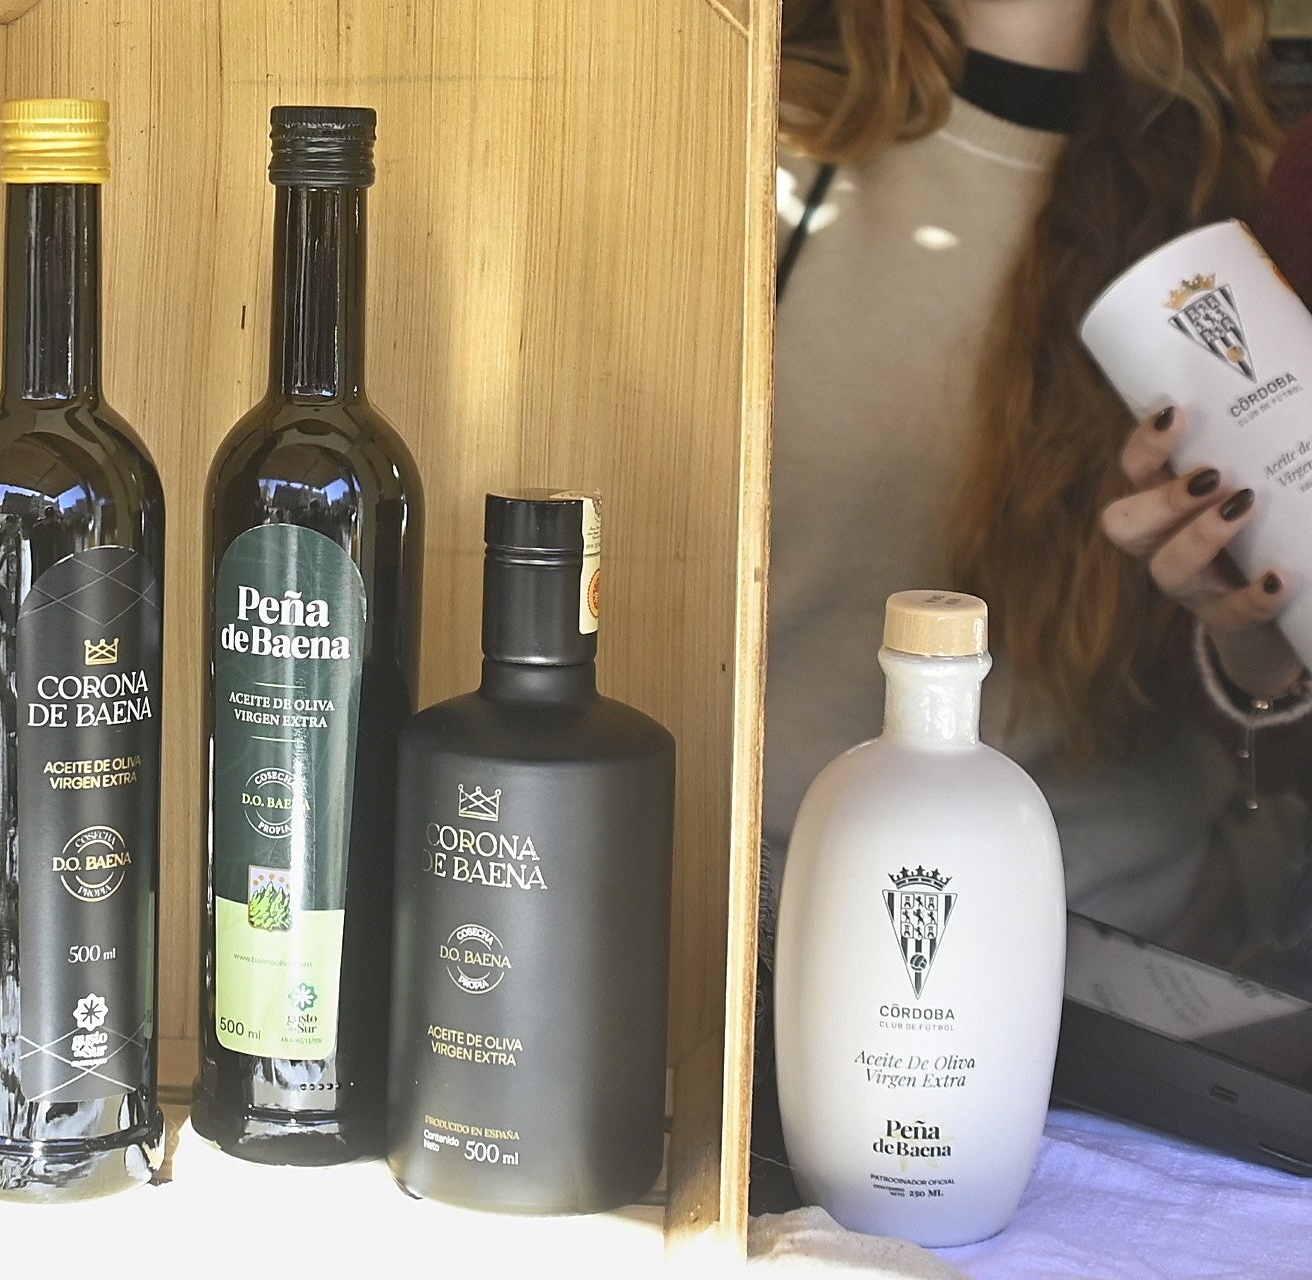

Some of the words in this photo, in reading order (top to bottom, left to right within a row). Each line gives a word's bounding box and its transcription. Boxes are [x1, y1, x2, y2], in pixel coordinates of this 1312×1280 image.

[1265, 449, 1298, 479] Aceite
[1298, 440, 1312, 456] de
[237, 585, 330, 628] Peña
[221, 624, 249, 653] de
[251, 626, 351, 660] Baena
[37, 670, 149, 700] CORONA
[27, 703, 68, 727] DE
[75, 695, 153, 728] BAENA
[229, 691, 270, 708] ACEITE
[272, 698, 293, 710] DE
[294, 700, 335, 712] OLIVA
[234, 708, 279, 726] VIRGEN
[282, 714, 327, 728] EXTRA
[43, 760, 92, 775] ACEITE
[93, 759, 111, 774] DE
[112, 755, 142, 771] OLIVA
[49, 776, 101, 790] VIRGEN
[102, 772, 138, 787] EXTRA
[241, 792, 265, 807] D.O.
[74, 830, 116, 849] COSECHA
[426, 822, 540, 861] CORONA
[52, 856, 81, 872] D.O.
[85, 852, 132, 870] BAENA
[452, 856, 548, 890] BAENA
[77, 884, 112, 898] PROPIA
[456, 927, 494, 946] COSECHA
[68, 944, 101, 964] 500
[103, 947, 116, 961] ml
[440, 945, 461, 962] D.O.
[464, 950, 512, 969] BAENA
[457, 974, 490, 990] PROPIA
[220, 1016, 245, 1036] 500
[248, 1030, 261, 1040] ml
[287, 1013, 318, 1026] gusto
[297, 1023, 317, 1034] Sur
[879, 1021, 903, 1029] CLUB
[427, 1024, 464, 1044] ACEITE
[466, 1033, 483, 1047] DE
[484, 1036, 523, 1052] OLIVA
[431, 1040, 472, 1062] VIRGEN
[474, 1050, 517, 1066] EXTRA
[854, 1051, 903, 1069] Aceite
[907, 1055, 930, 1071] De
[934, 1054, 976, 1071] Oliva
[866, 1068, 917, 1089] Virgen
[922, 1073, 967, 1088] Extra
[423, 1128, 460, 1147] Contenido
[424, 1114, 470, 1134] PRODUCIDO
[470, 1126, 483, 1137] EN
[484, 1128, 520, 1141] ESPAÑA
[886, 1119, 940, 1140] Peña
[423, 1139, 440, 1152] Neto
[464, 1140, 500, 1164] 500
[502, 1152, 519, 1166] ml
[872, 1138, 895, 1155] de
[896, 1141, 952, 1157] Baena
